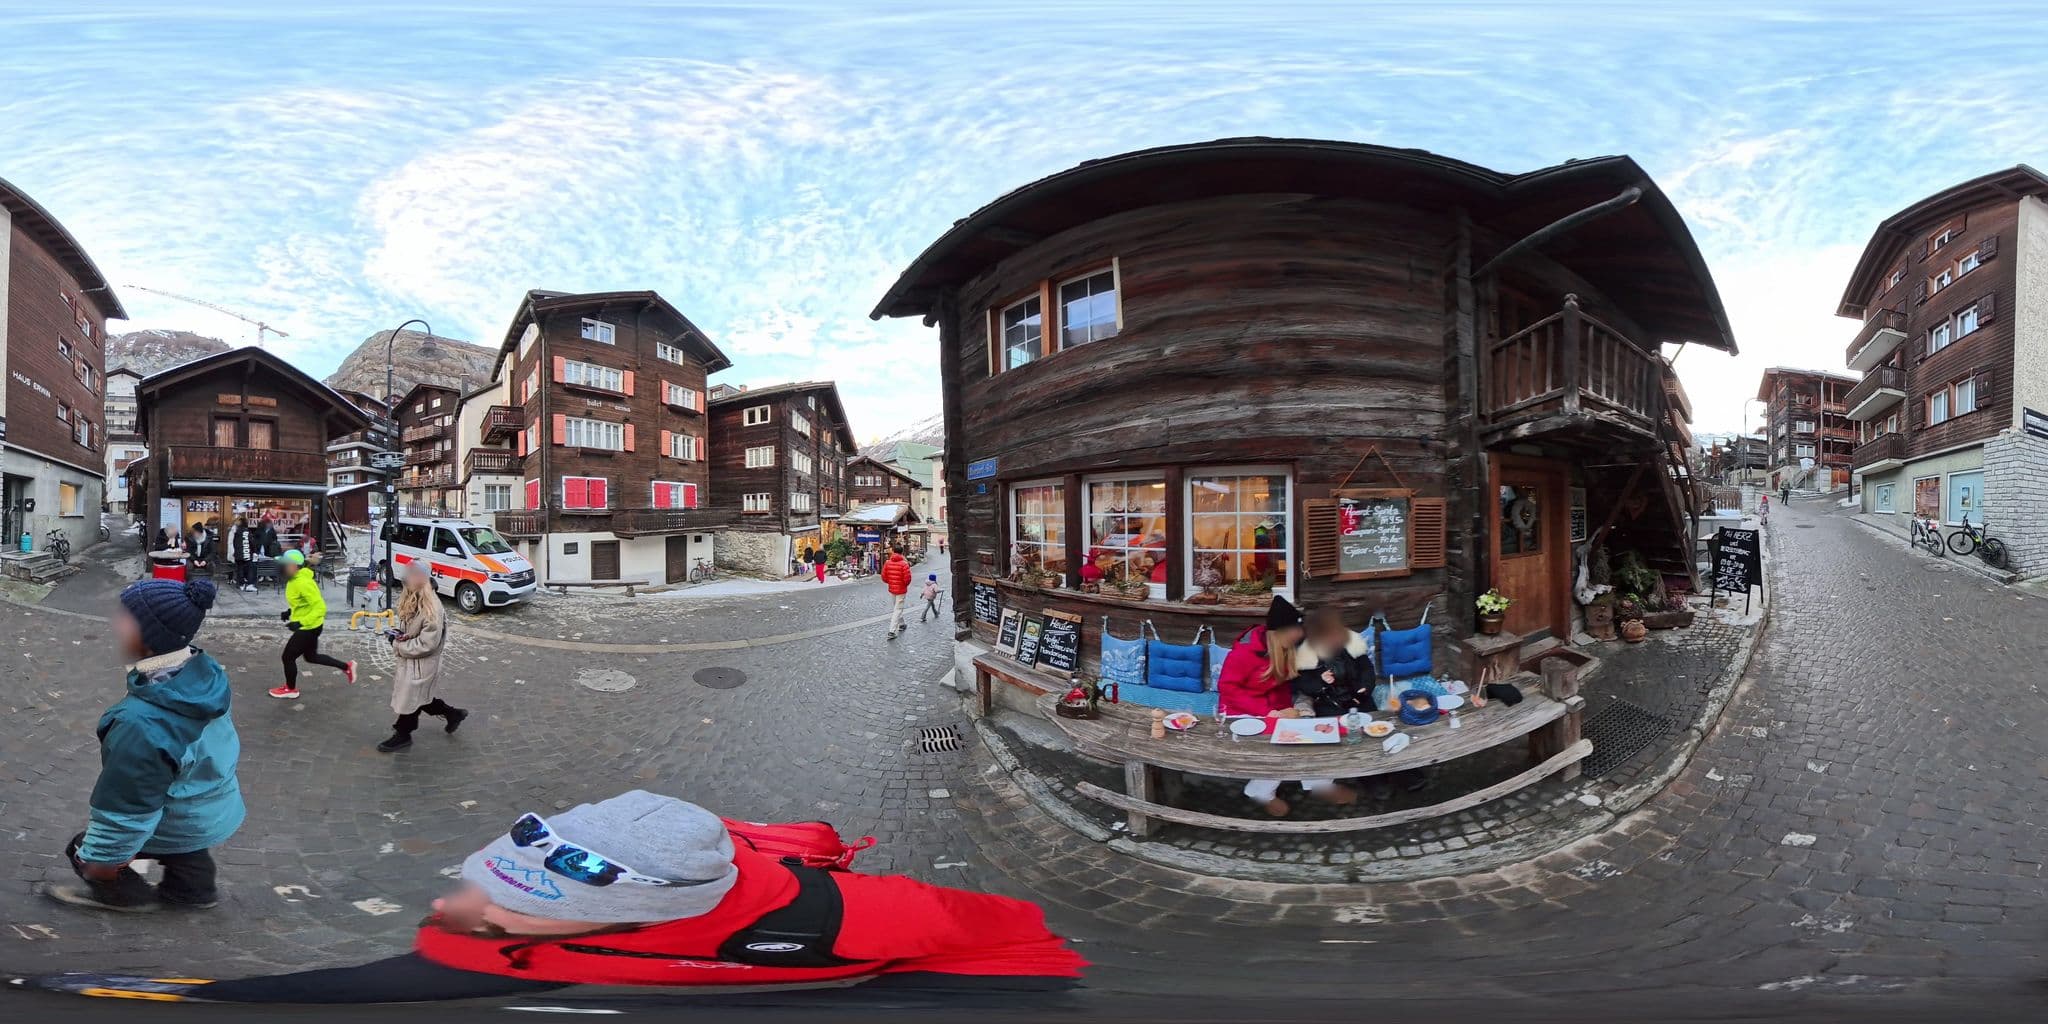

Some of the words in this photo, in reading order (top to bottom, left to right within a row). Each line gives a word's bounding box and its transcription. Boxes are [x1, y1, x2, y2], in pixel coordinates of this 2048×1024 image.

[12, 370, 31, 386] HAUS
[1733, 531, 1752, 541] HERZ
[502, 556, 524, 565] POLICE
[1049, 618, 1073, 630] Heute
[1049, 657, 1070, 668] Kuchen
